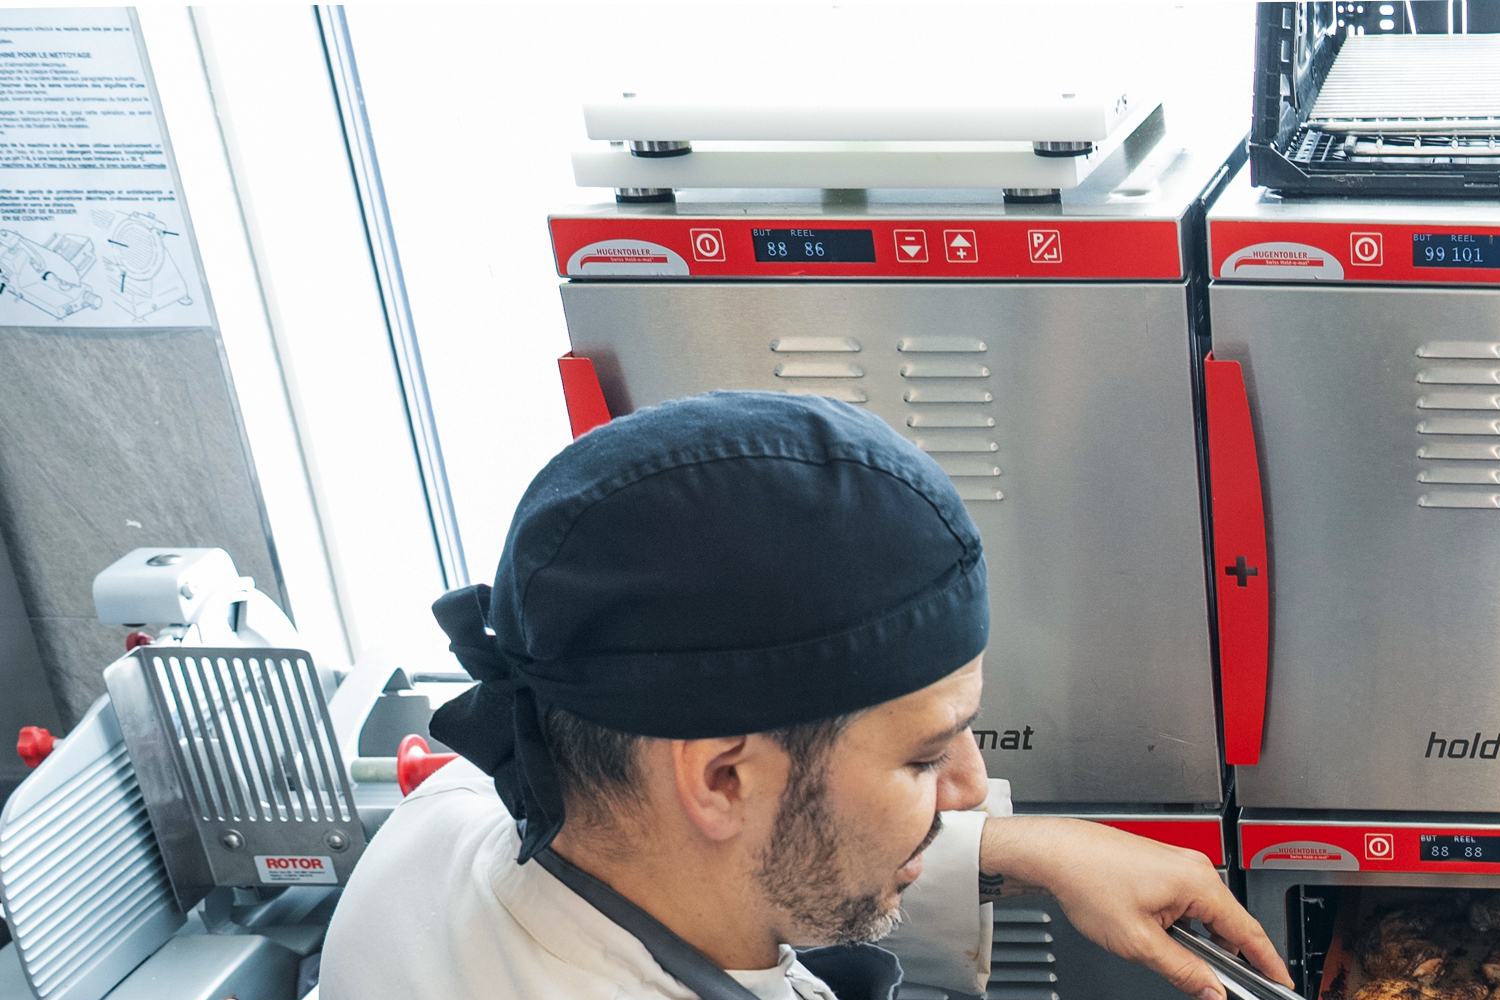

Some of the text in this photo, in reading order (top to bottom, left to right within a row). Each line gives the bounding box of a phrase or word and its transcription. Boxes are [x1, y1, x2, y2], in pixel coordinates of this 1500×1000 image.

[753, 229, 815, 238] BUT REEL
[1413, 234, 1475, 243] BUT REEL
[596, 248, 652, 256] HUGENTOBLER
[767, 241, 825, 257] 88 86
[1252, 250, 1308, 259] HUGENTOBLER
[1424, 246, 1484, 263] 99 101
[972, 725, 1035, 750] mat
[1420, 834, 1476, 844] BUT REEL
[1431, 846, 1482, 857] 88 88
[265, 858, 323, 869] ROTOR
